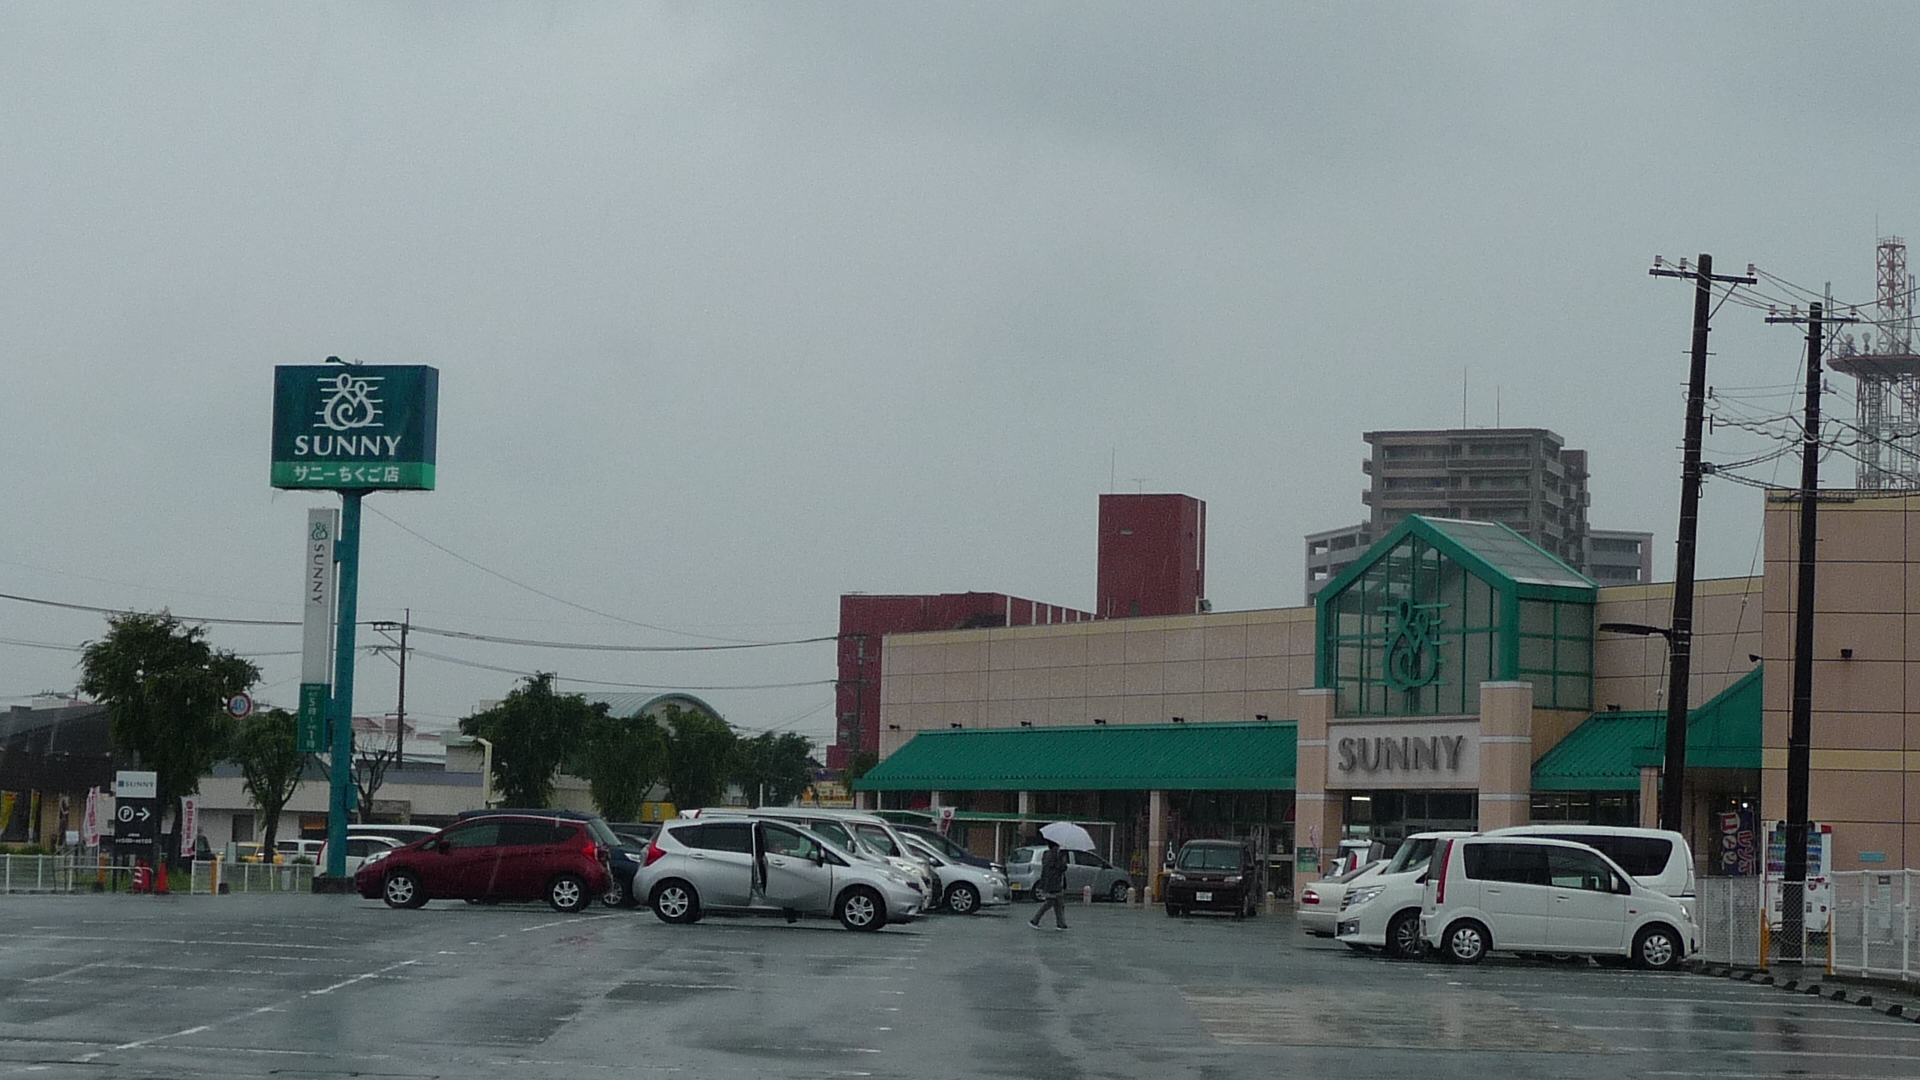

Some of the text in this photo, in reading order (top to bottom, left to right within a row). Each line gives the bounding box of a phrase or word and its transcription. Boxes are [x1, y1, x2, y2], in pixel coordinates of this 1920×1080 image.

[294, 435, 402, 456] SUNNY
[294, 465, 400, 483] サニーちくご店
[312, 543, 326, 605] SUNNY
[232, 699, 246, 711] 40
[1338, 734, 1465, 772] SUNNY
